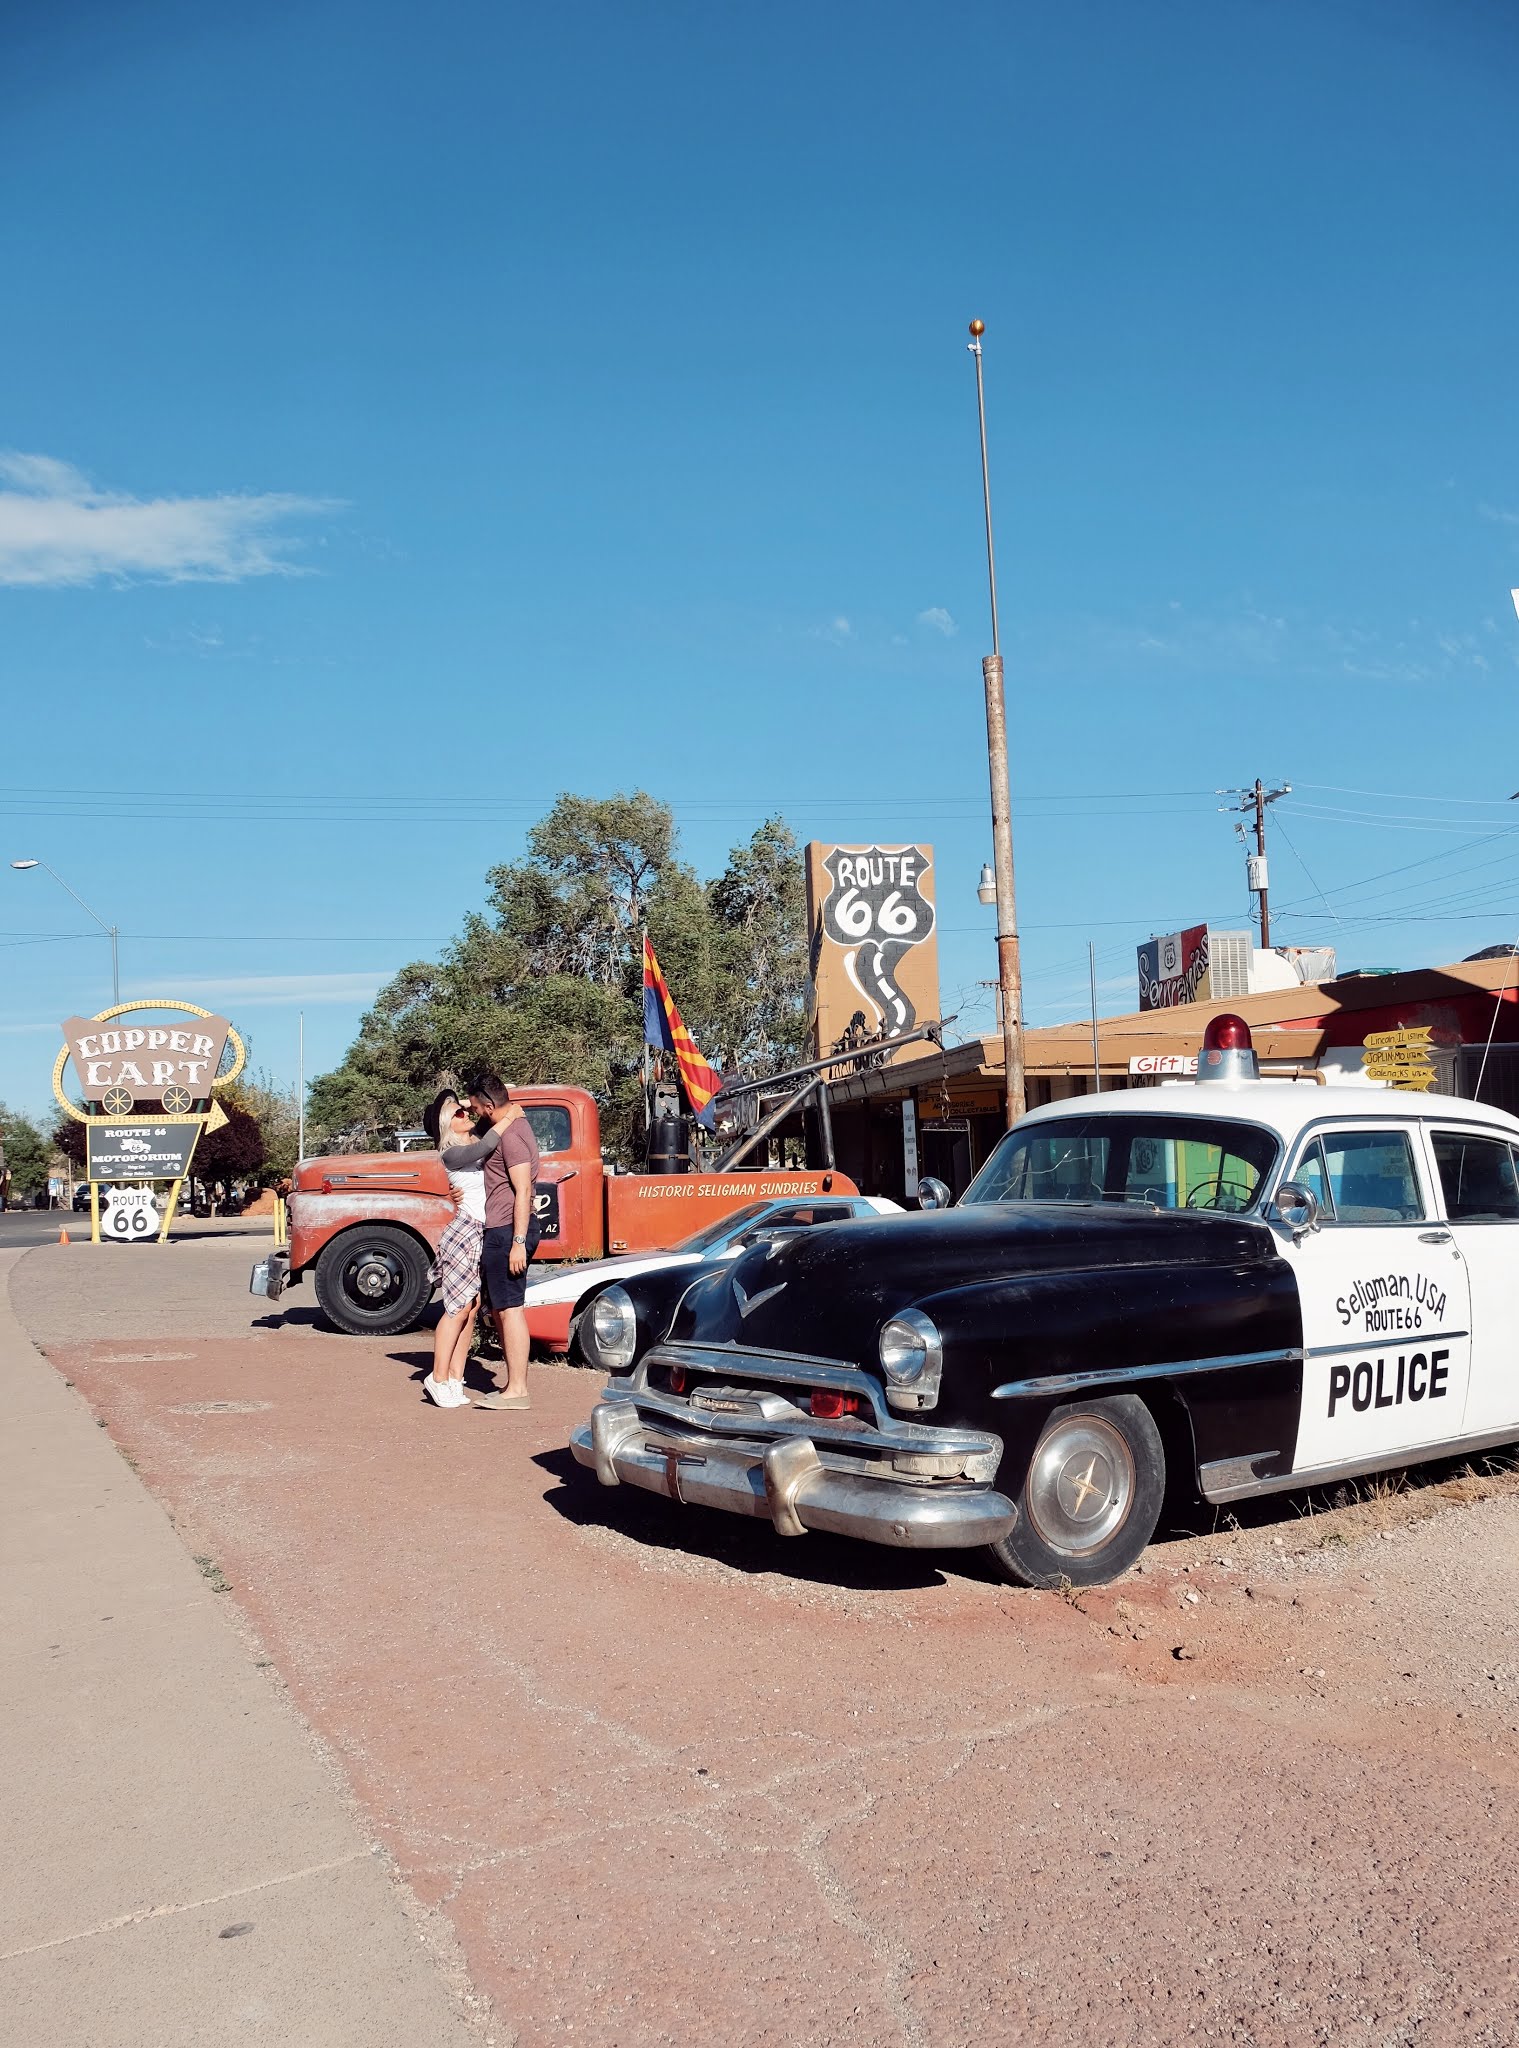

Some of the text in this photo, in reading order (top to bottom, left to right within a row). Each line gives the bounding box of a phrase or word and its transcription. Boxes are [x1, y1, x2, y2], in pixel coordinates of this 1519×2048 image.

[837, 855, 916, 888] ROUTE
[834, 887, 917, 937] 66
[75, 1028, 215, 1060] COPPER
[86, 1059, 208, 1087] CART
[1137, 1056, 1179, 1072] Gift
[105, 1128, 167, 1138] ROUTE 66
[91, 1153, 182, 1163] MOTOPORIUM
[112, 1194, 148, 1206] ROUTE
[638, 1181, 818, 1198] HISTORIC SELIGMAN SUNDRIES
[113, 1208, 148, 1233] 66
[545, 1223, 558, 1233] AZ
[1336, 1273, 1447, 1326] Seligman, USA
[1365, 1307, 1422, 1332] ROUTE 66
[1327, 1349, 1450, 1418] POLICE
